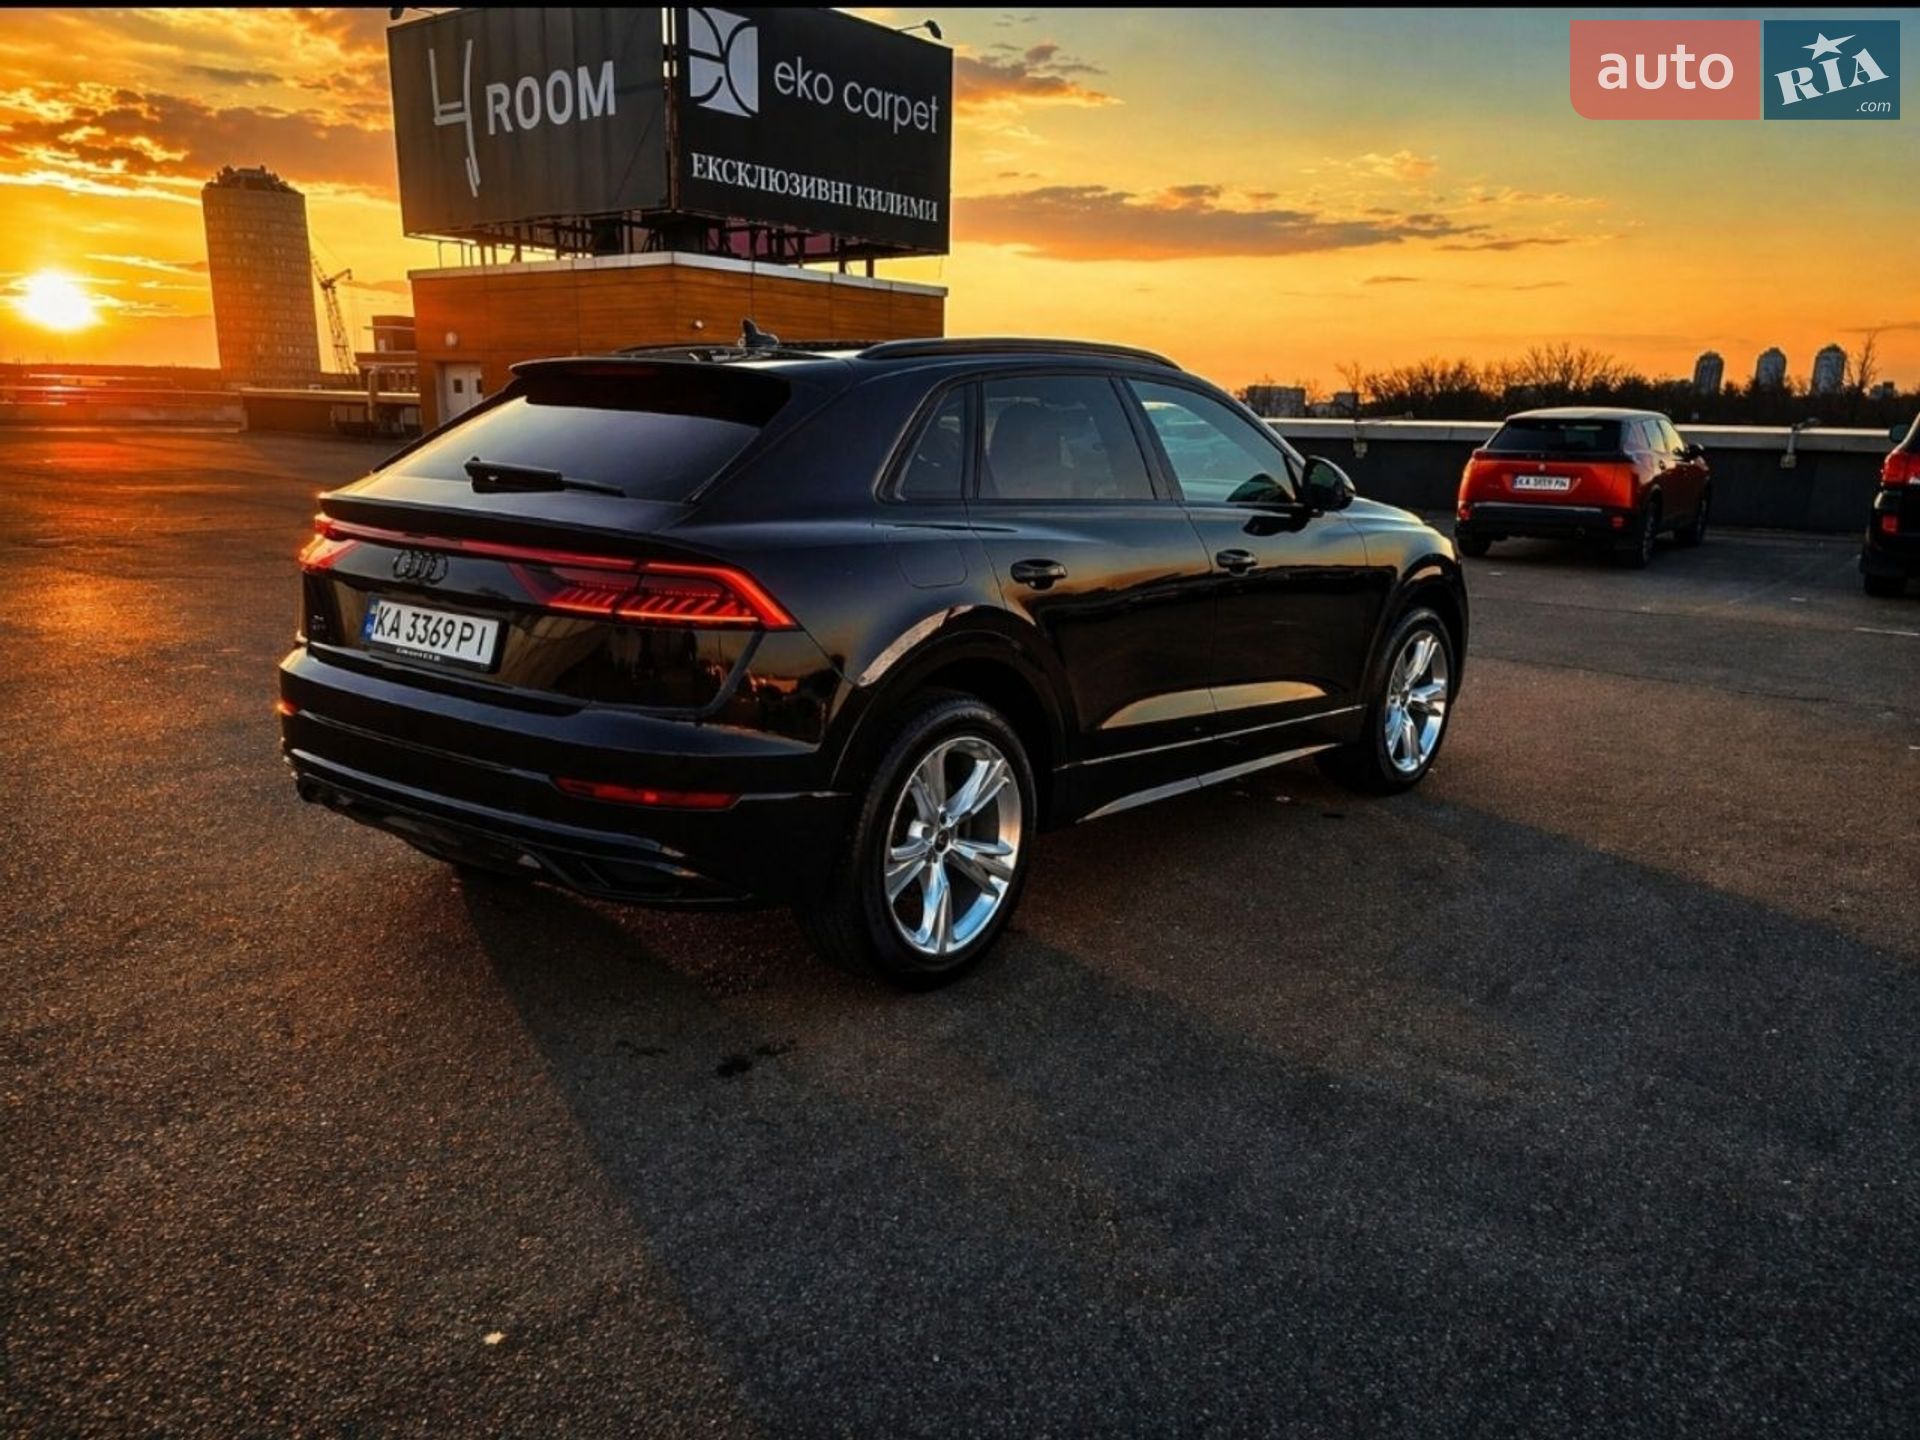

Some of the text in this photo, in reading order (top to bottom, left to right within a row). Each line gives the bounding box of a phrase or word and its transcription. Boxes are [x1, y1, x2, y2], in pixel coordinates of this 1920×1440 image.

[486, 60, 616, 134] ROOM
[774, 56, 939, 134] eko carpet
[691, 152, 939, 222] ЕКСКЛЮЗИВНІ КИЛИМИ
[406, 612, 456, 649] 3369
